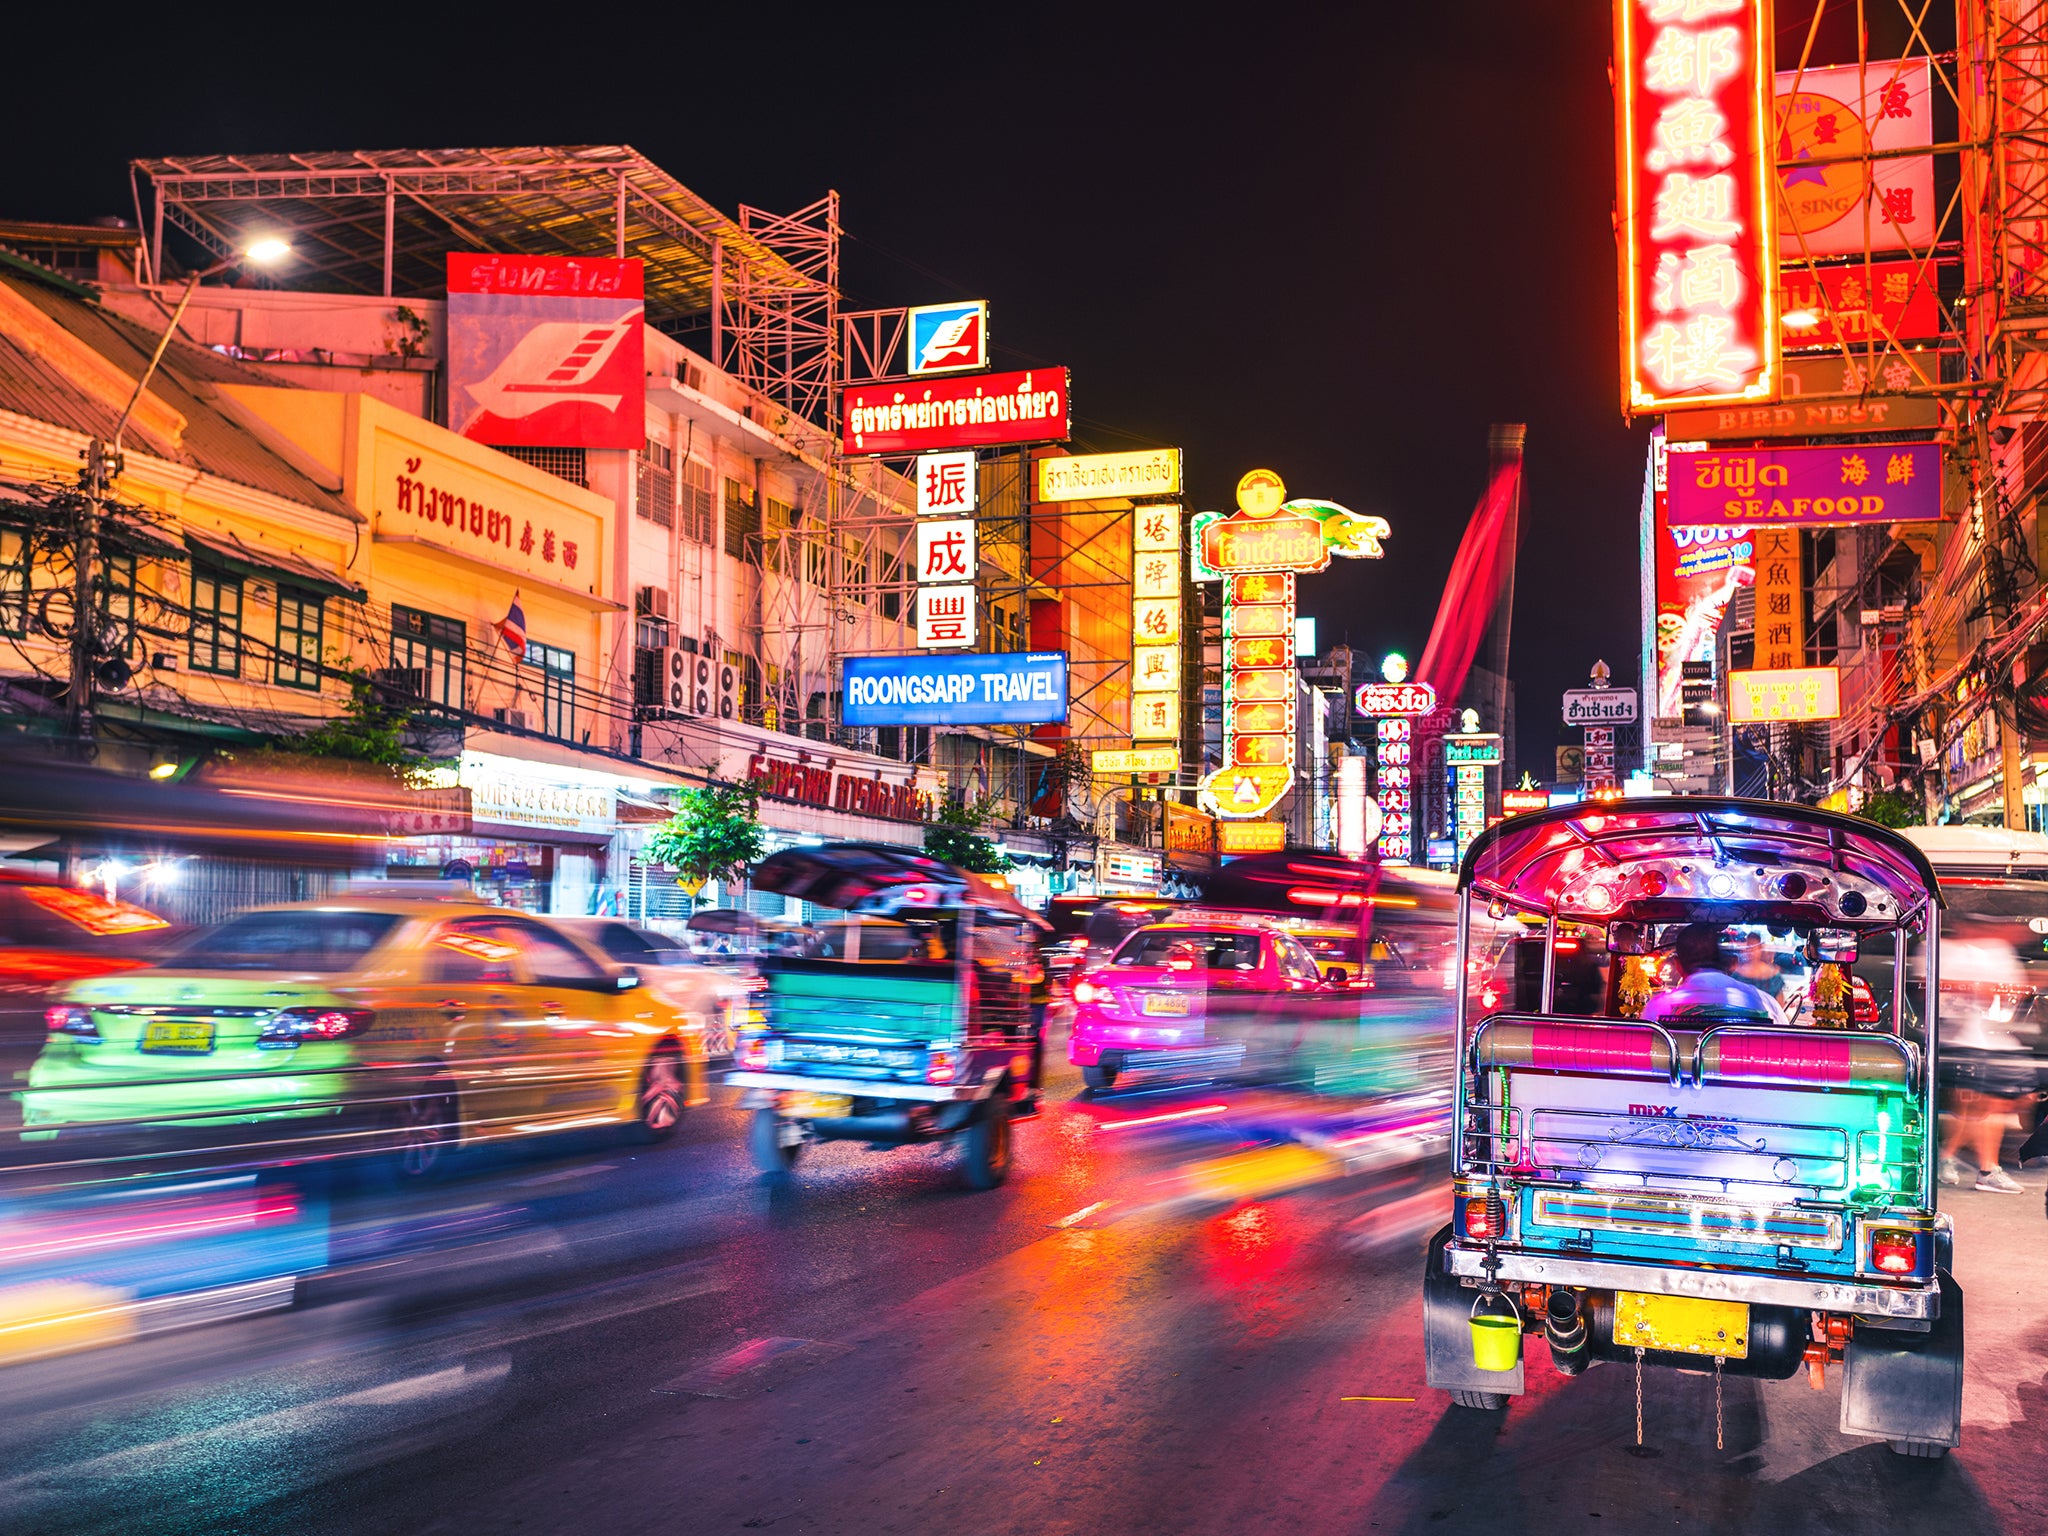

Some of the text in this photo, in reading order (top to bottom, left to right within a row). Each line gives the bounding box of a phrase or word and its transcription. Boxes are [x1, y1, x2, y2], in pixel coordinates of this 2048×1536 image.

[1801, 196, 1849, 215] SING
[850, 371, 1060, 449] รุ่งทรัพย์การท่องเที่ยว
[1717, 403, 1889, 431] BIRD NEST
[1840, 452, 1916, 487] 海鮮
[396, 456, 512, 549] ห้างขายยา
[1723, 495, 1886, 519] SEAFOOD
[924, 461, 967, 642] 振成豐
[1683, 666, 1710, 674] CITIZEN
[849, 672, 1059, 706] ROONGSARP TRAVEL
[1684, 689, 1711, 698] RADO
